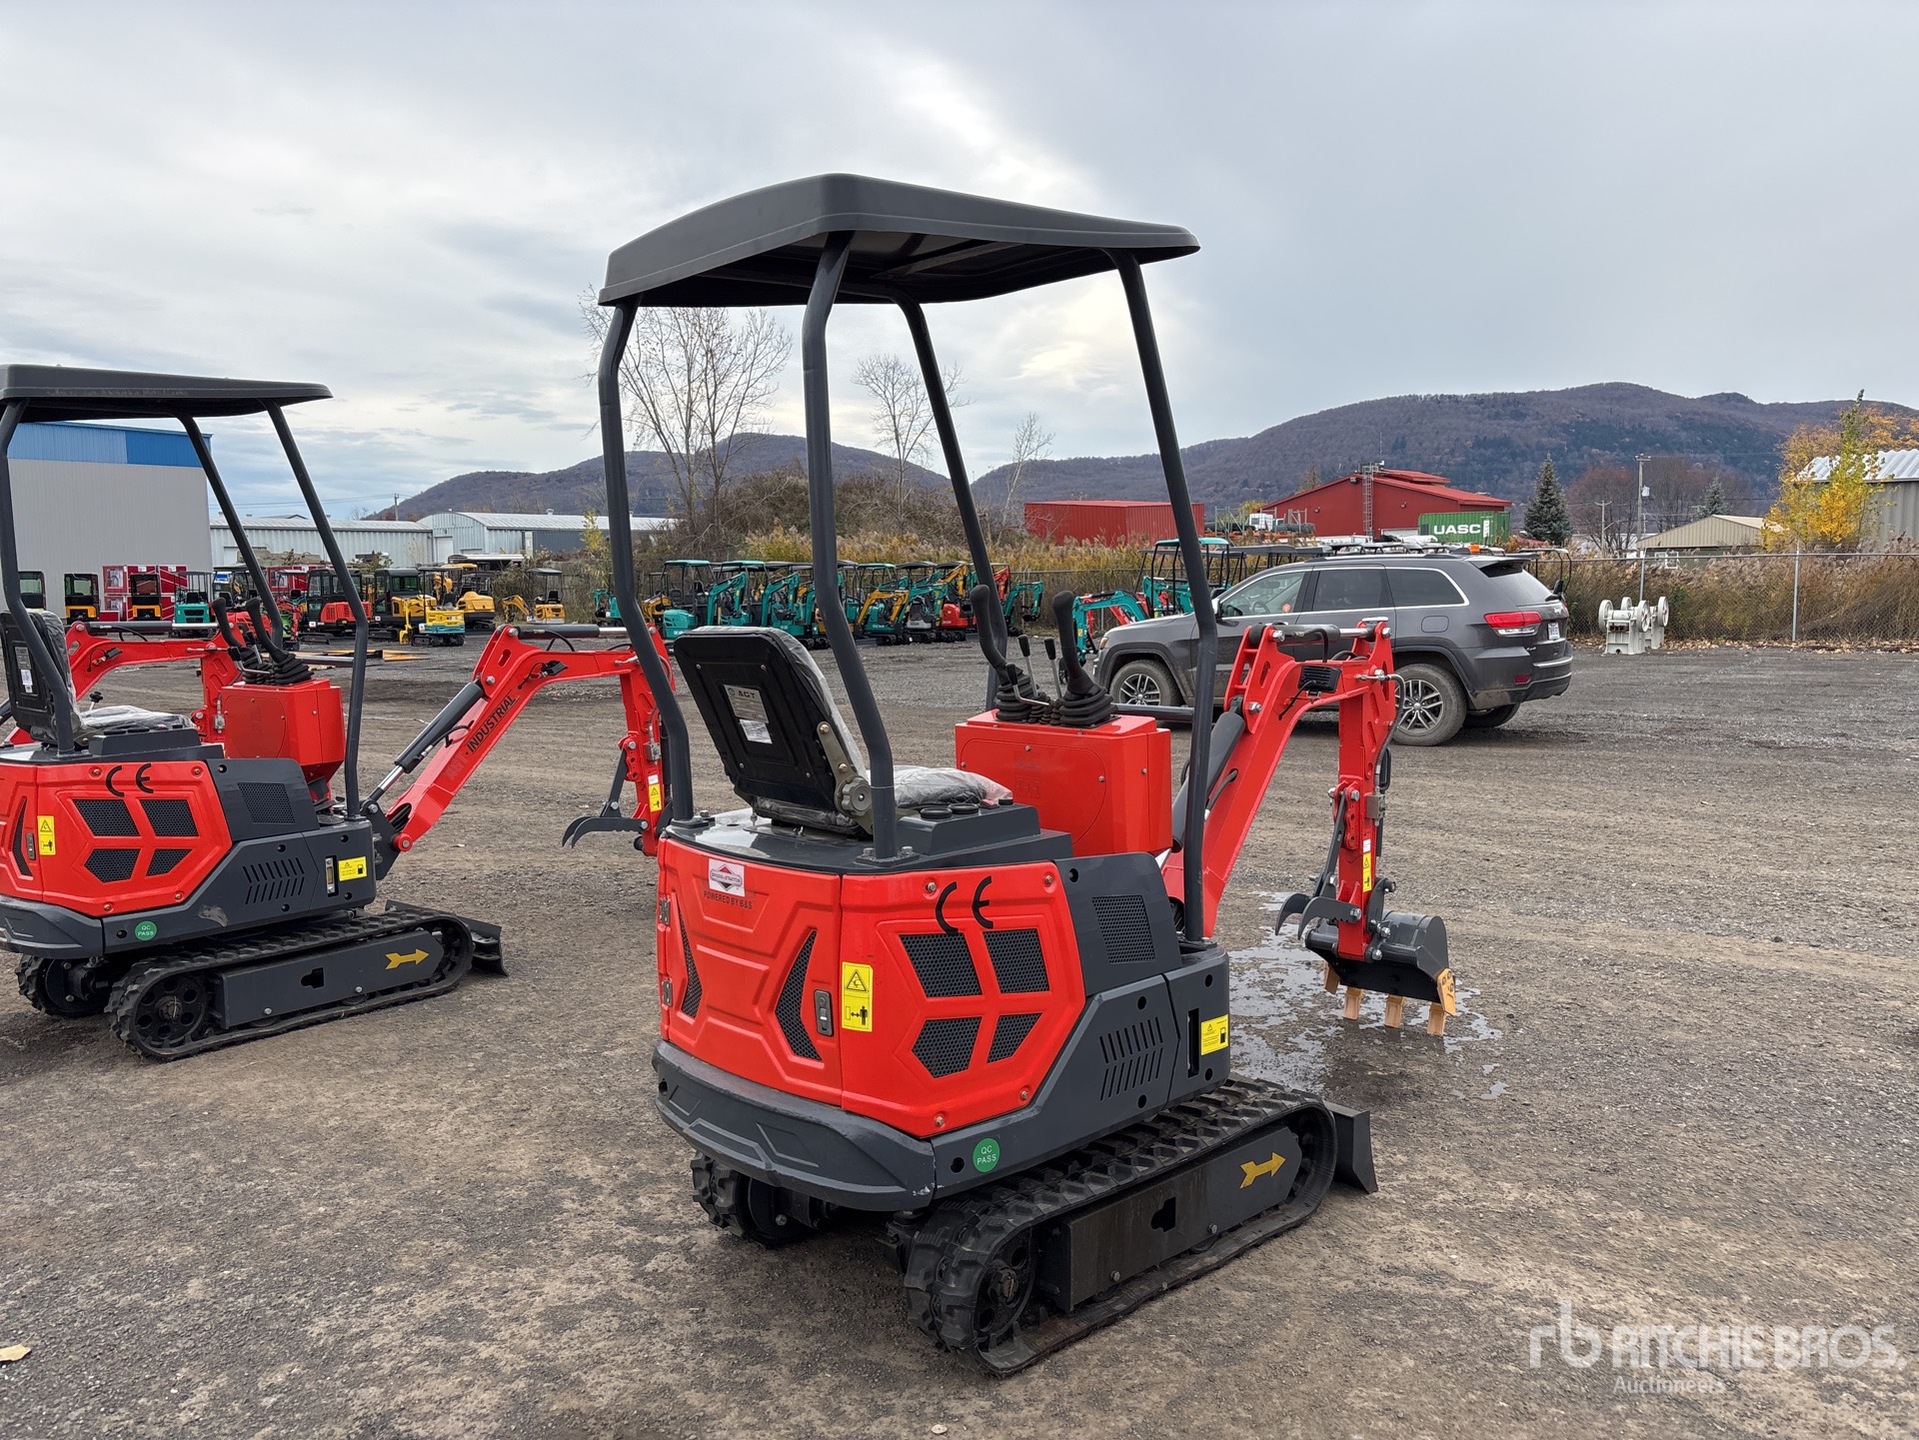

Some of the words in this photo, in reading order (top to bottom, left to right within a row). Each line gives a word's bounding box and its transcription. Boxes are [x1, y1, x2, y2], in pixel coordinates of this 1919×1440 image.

[1433, 523, 1481, 535] UASC
[466, 695, 517, 753] INDUSTRIAL
[703, 890, 731, 905] POWERED
[730, 897, 739, 906] BY
[980, 1145, 993, 1155] QC
[976, 1153, 997, 1166] PASS
